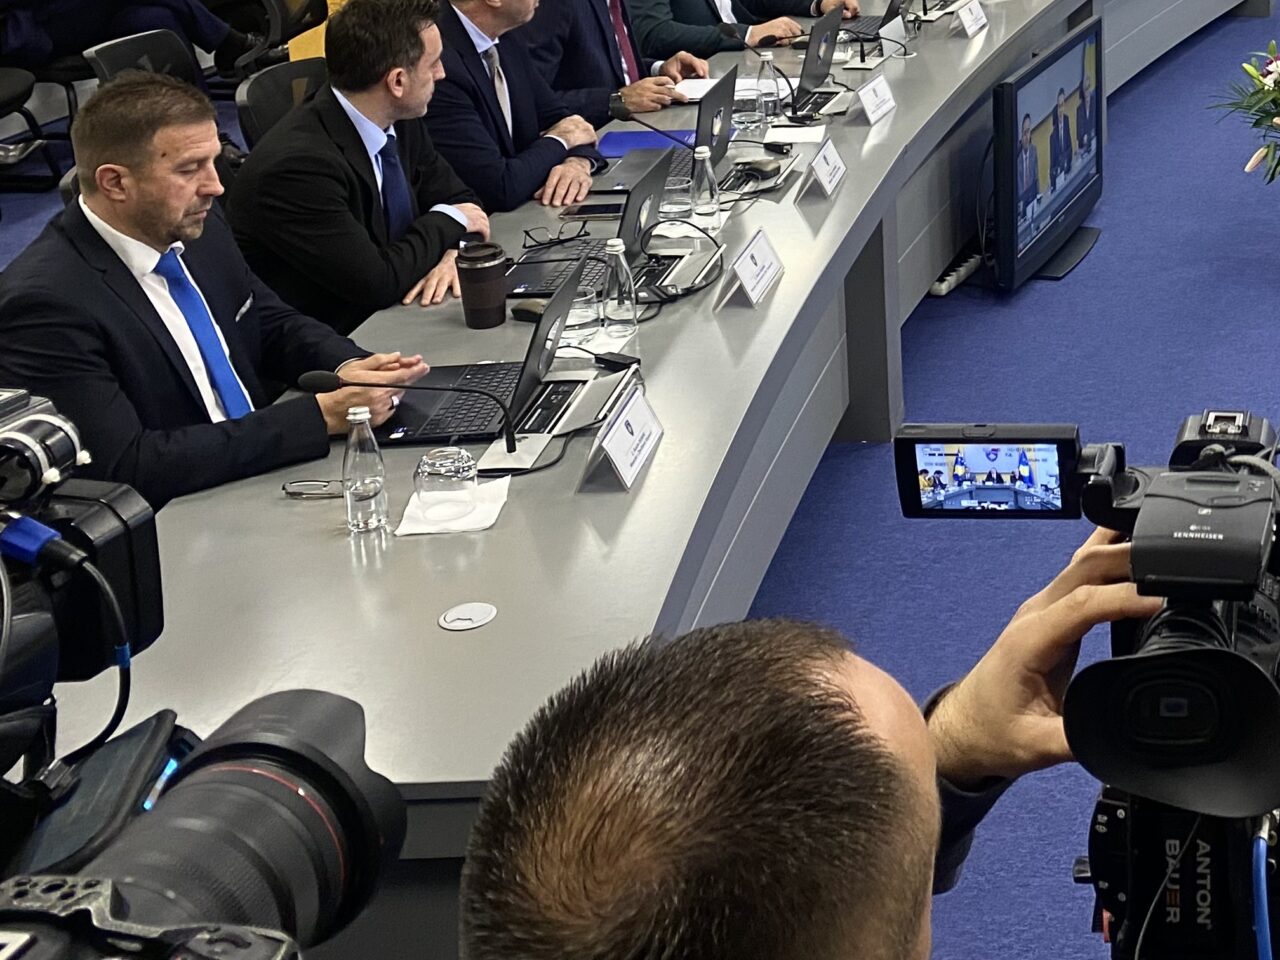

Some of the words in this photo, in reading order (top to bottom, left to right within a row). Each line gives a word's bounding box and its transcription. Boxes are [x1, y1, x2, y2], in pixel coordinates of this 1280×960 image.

[1173, 531, 1224, 540] SENNHEISER
[1165, 839, 1180, 924] BAUER
[1196, 840, 1211, 925] ANTON
